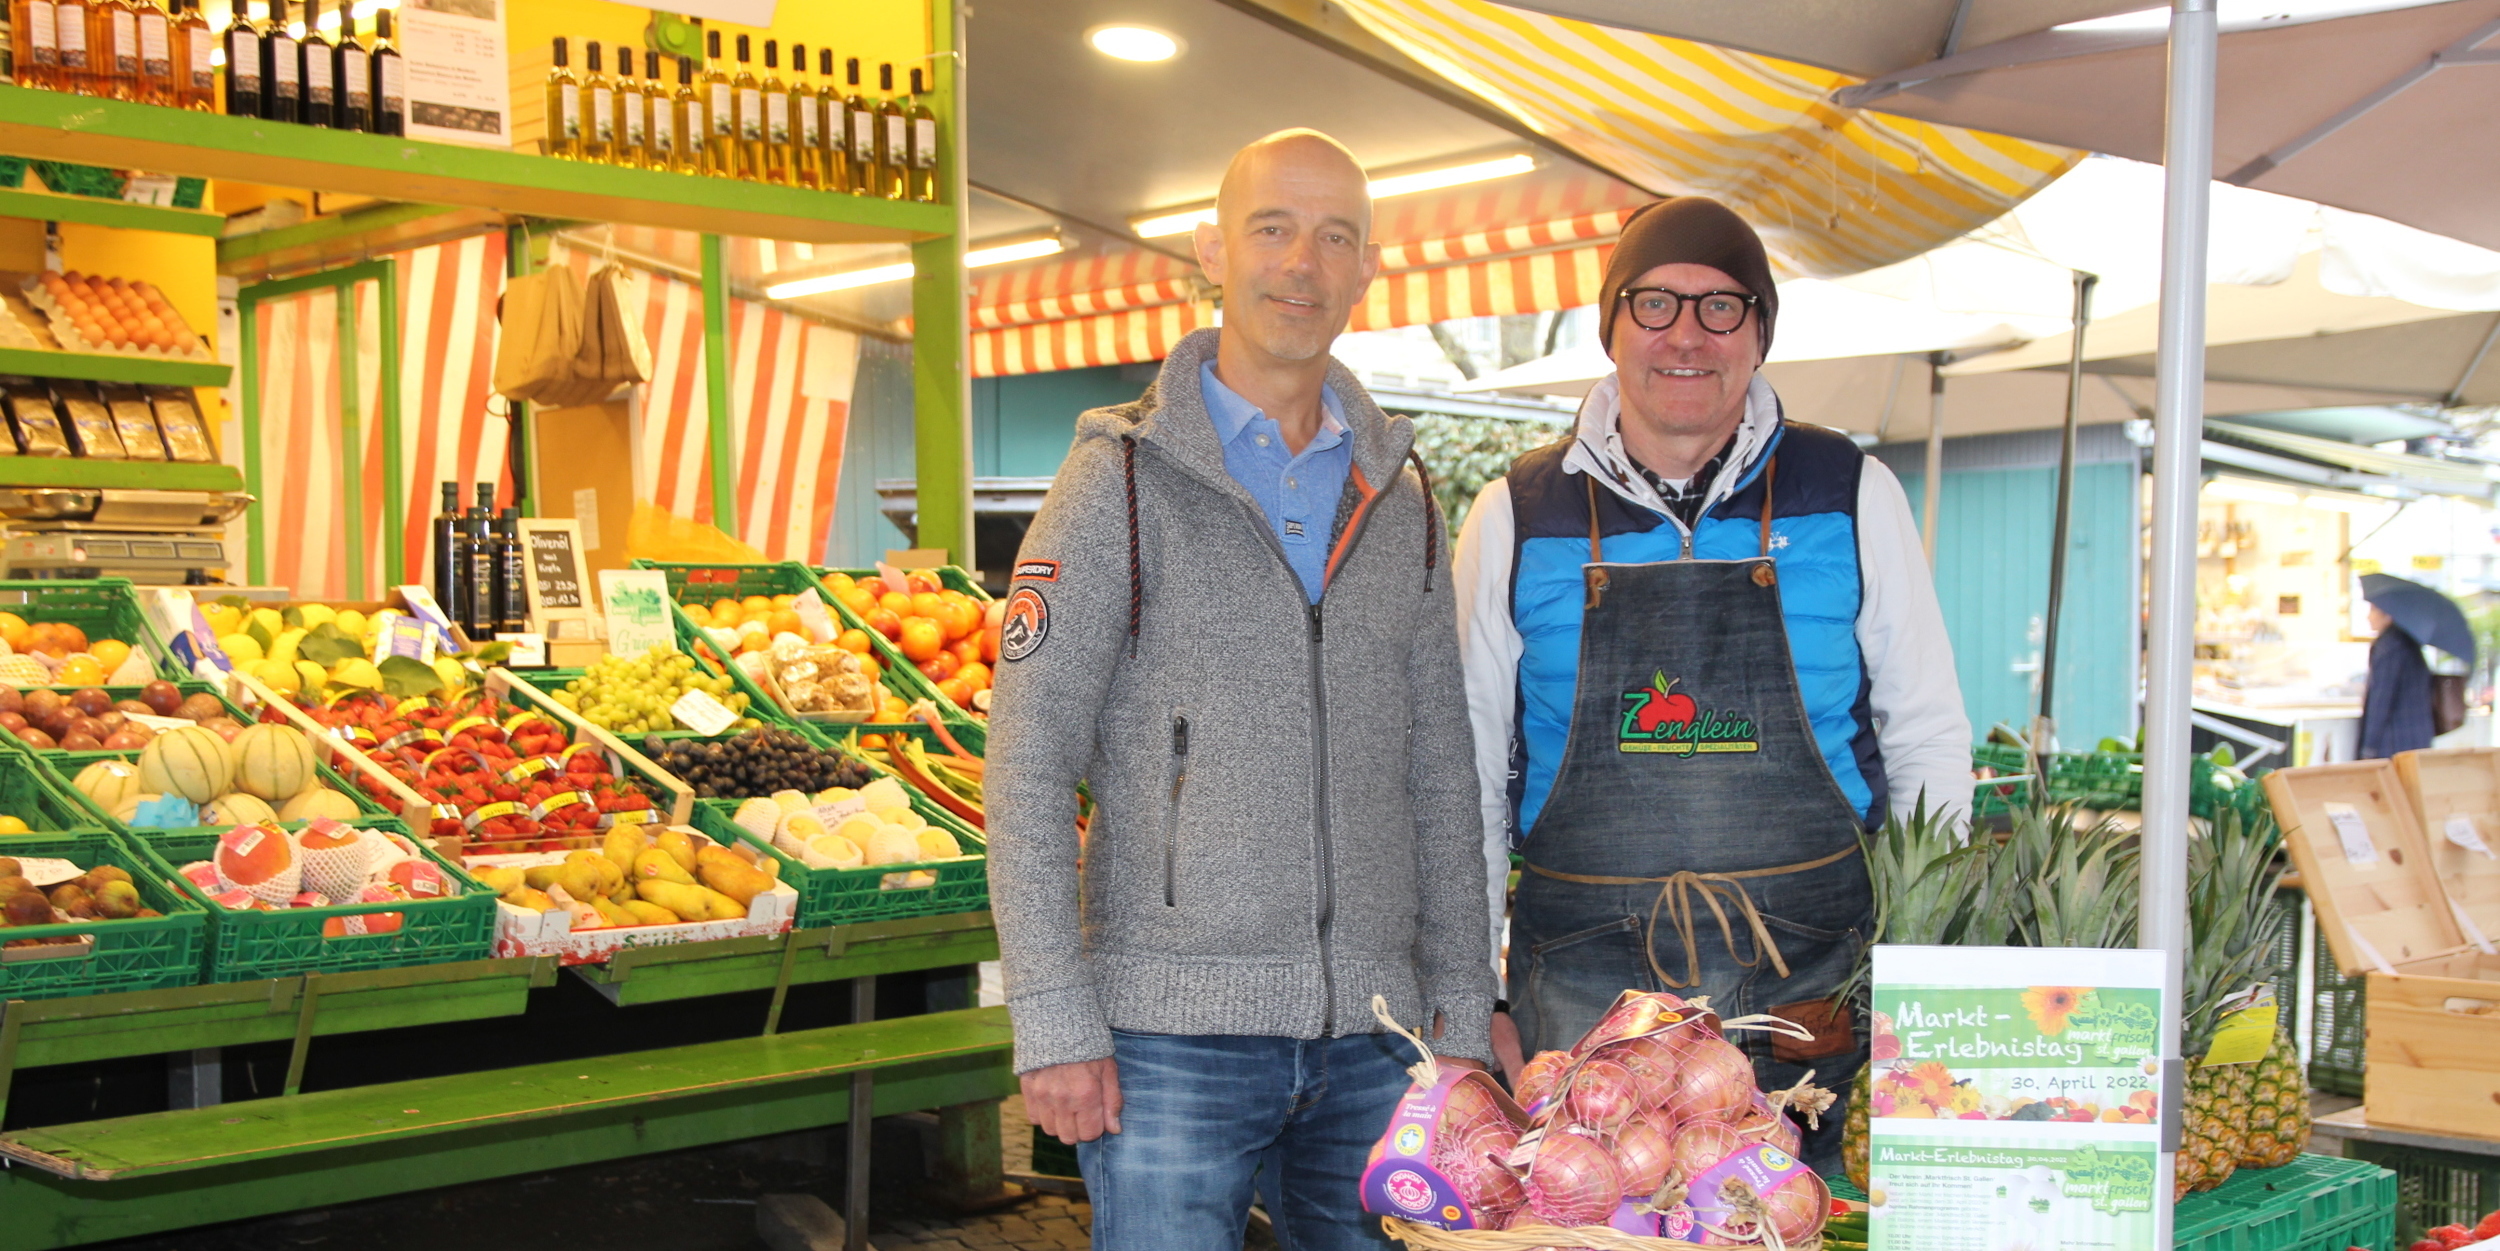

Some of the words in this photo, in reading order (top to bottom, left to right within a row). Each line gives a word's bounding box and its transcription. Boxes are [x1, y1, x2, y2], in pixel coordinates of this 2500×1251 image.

[531, 534, 570, 550] Olivenöl
[1620, 692, 1756, 758] Zenglein
[1906, 1031, 2083, 1065] Erlebnistag
[2095, 1045, 2111, 1056] st.
[2112, 1045, 2151, 1060] gallen
[2011, 1075, 2041, 1091] 30.
[2047, 1074, 2097, 1096] April
[2106, 1075, 2149, 1090] 2022
[1411, 1111, 1433, 1120] main
[1879, 1147, 2024, 1169] Markt-Erlebnistag
[2027, 1155, 2068, 1164] 30.04.2022
[1392, 1172, 1422, 1184] OIGNON
[2093, 1197, 2108, 1208] st.
[2109, 1197, 2148, 1212] gallen
